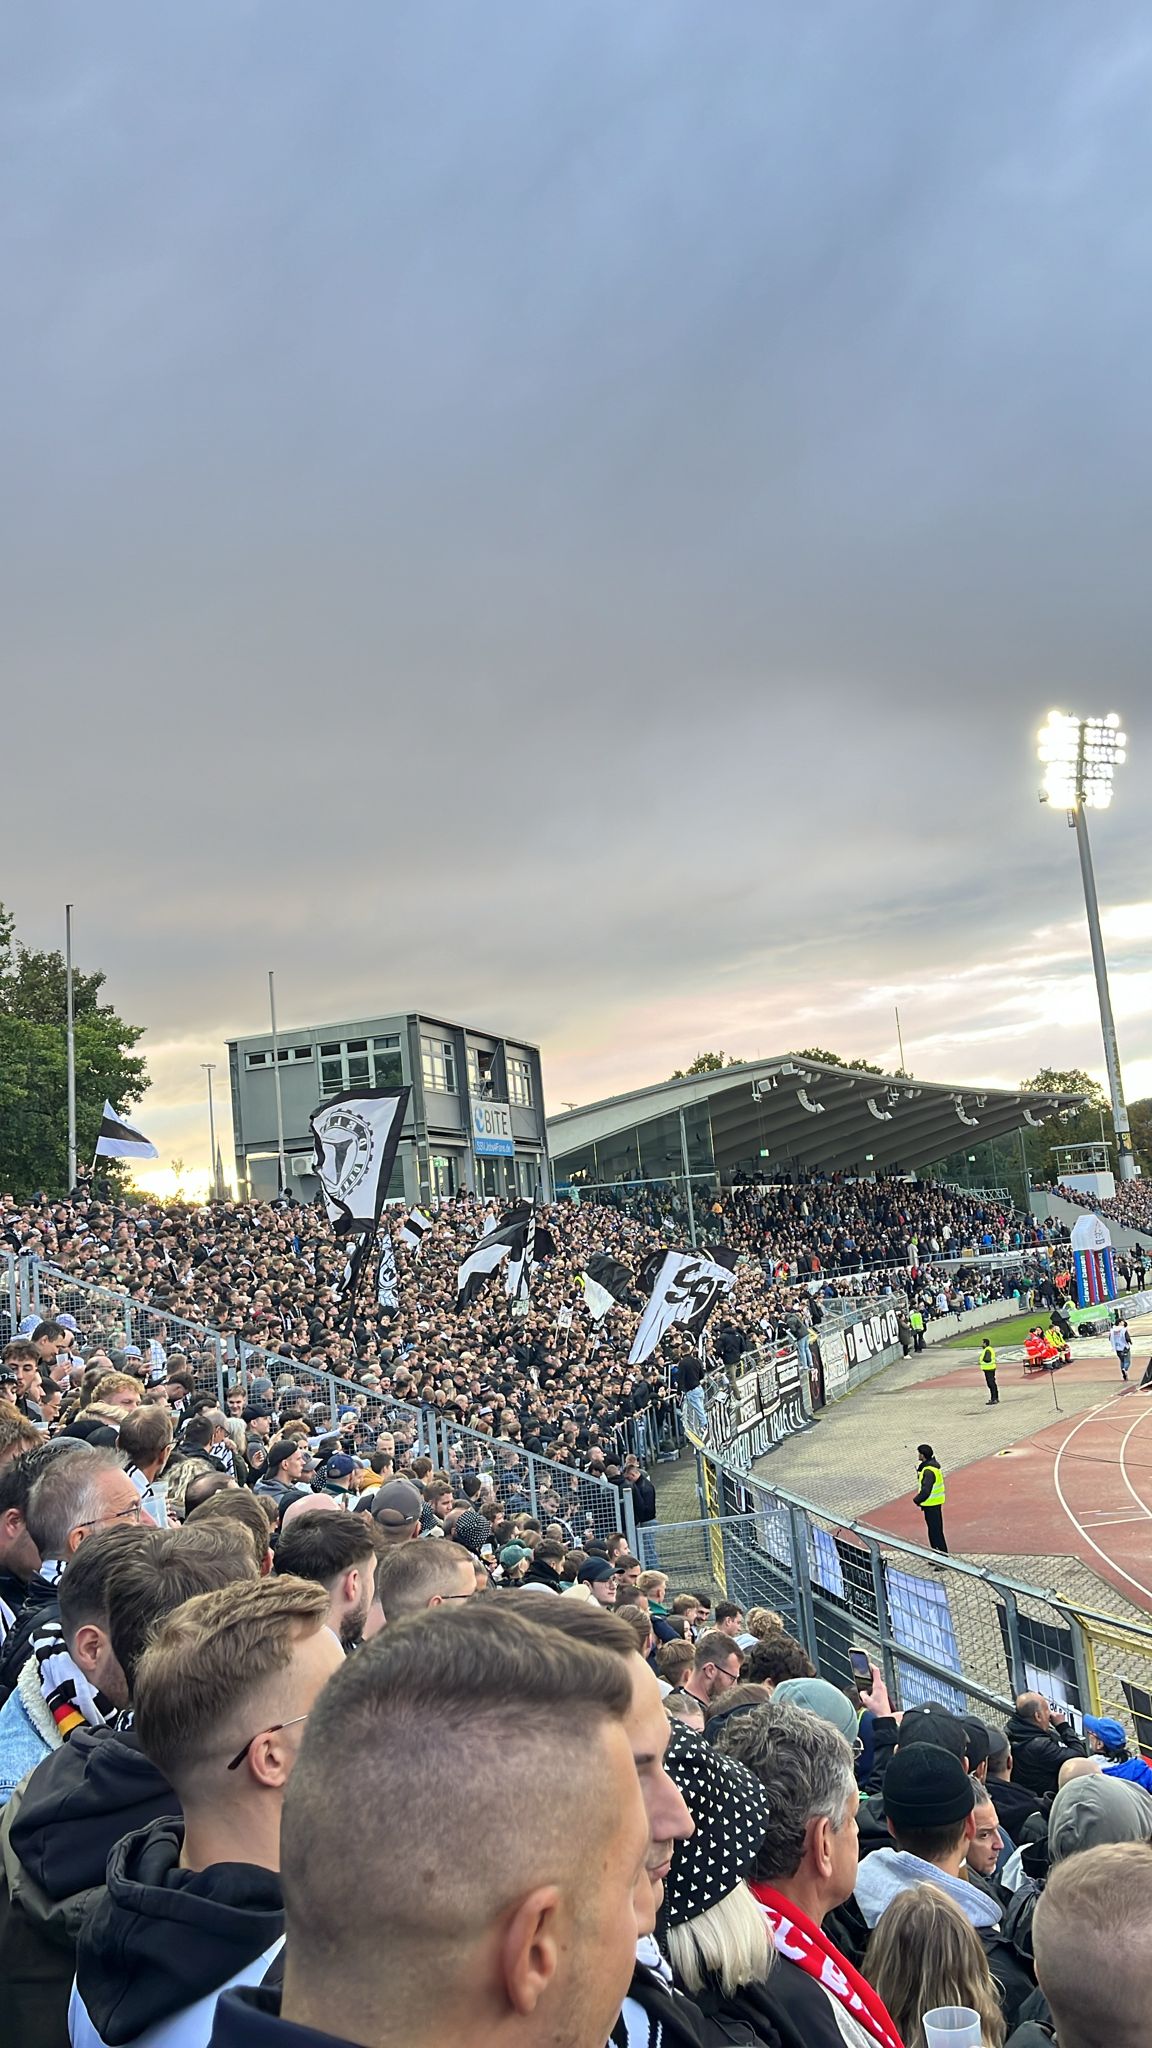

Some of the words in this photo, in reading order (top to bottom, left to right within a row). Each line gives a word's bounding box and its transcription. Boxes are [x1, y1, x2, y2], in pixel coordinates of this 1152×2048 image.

[484, 1109, 508, 1136] BITE
[1080, 1255, 1088, 1278] bauen
[1082, 1278, 1090, 1303] clever
